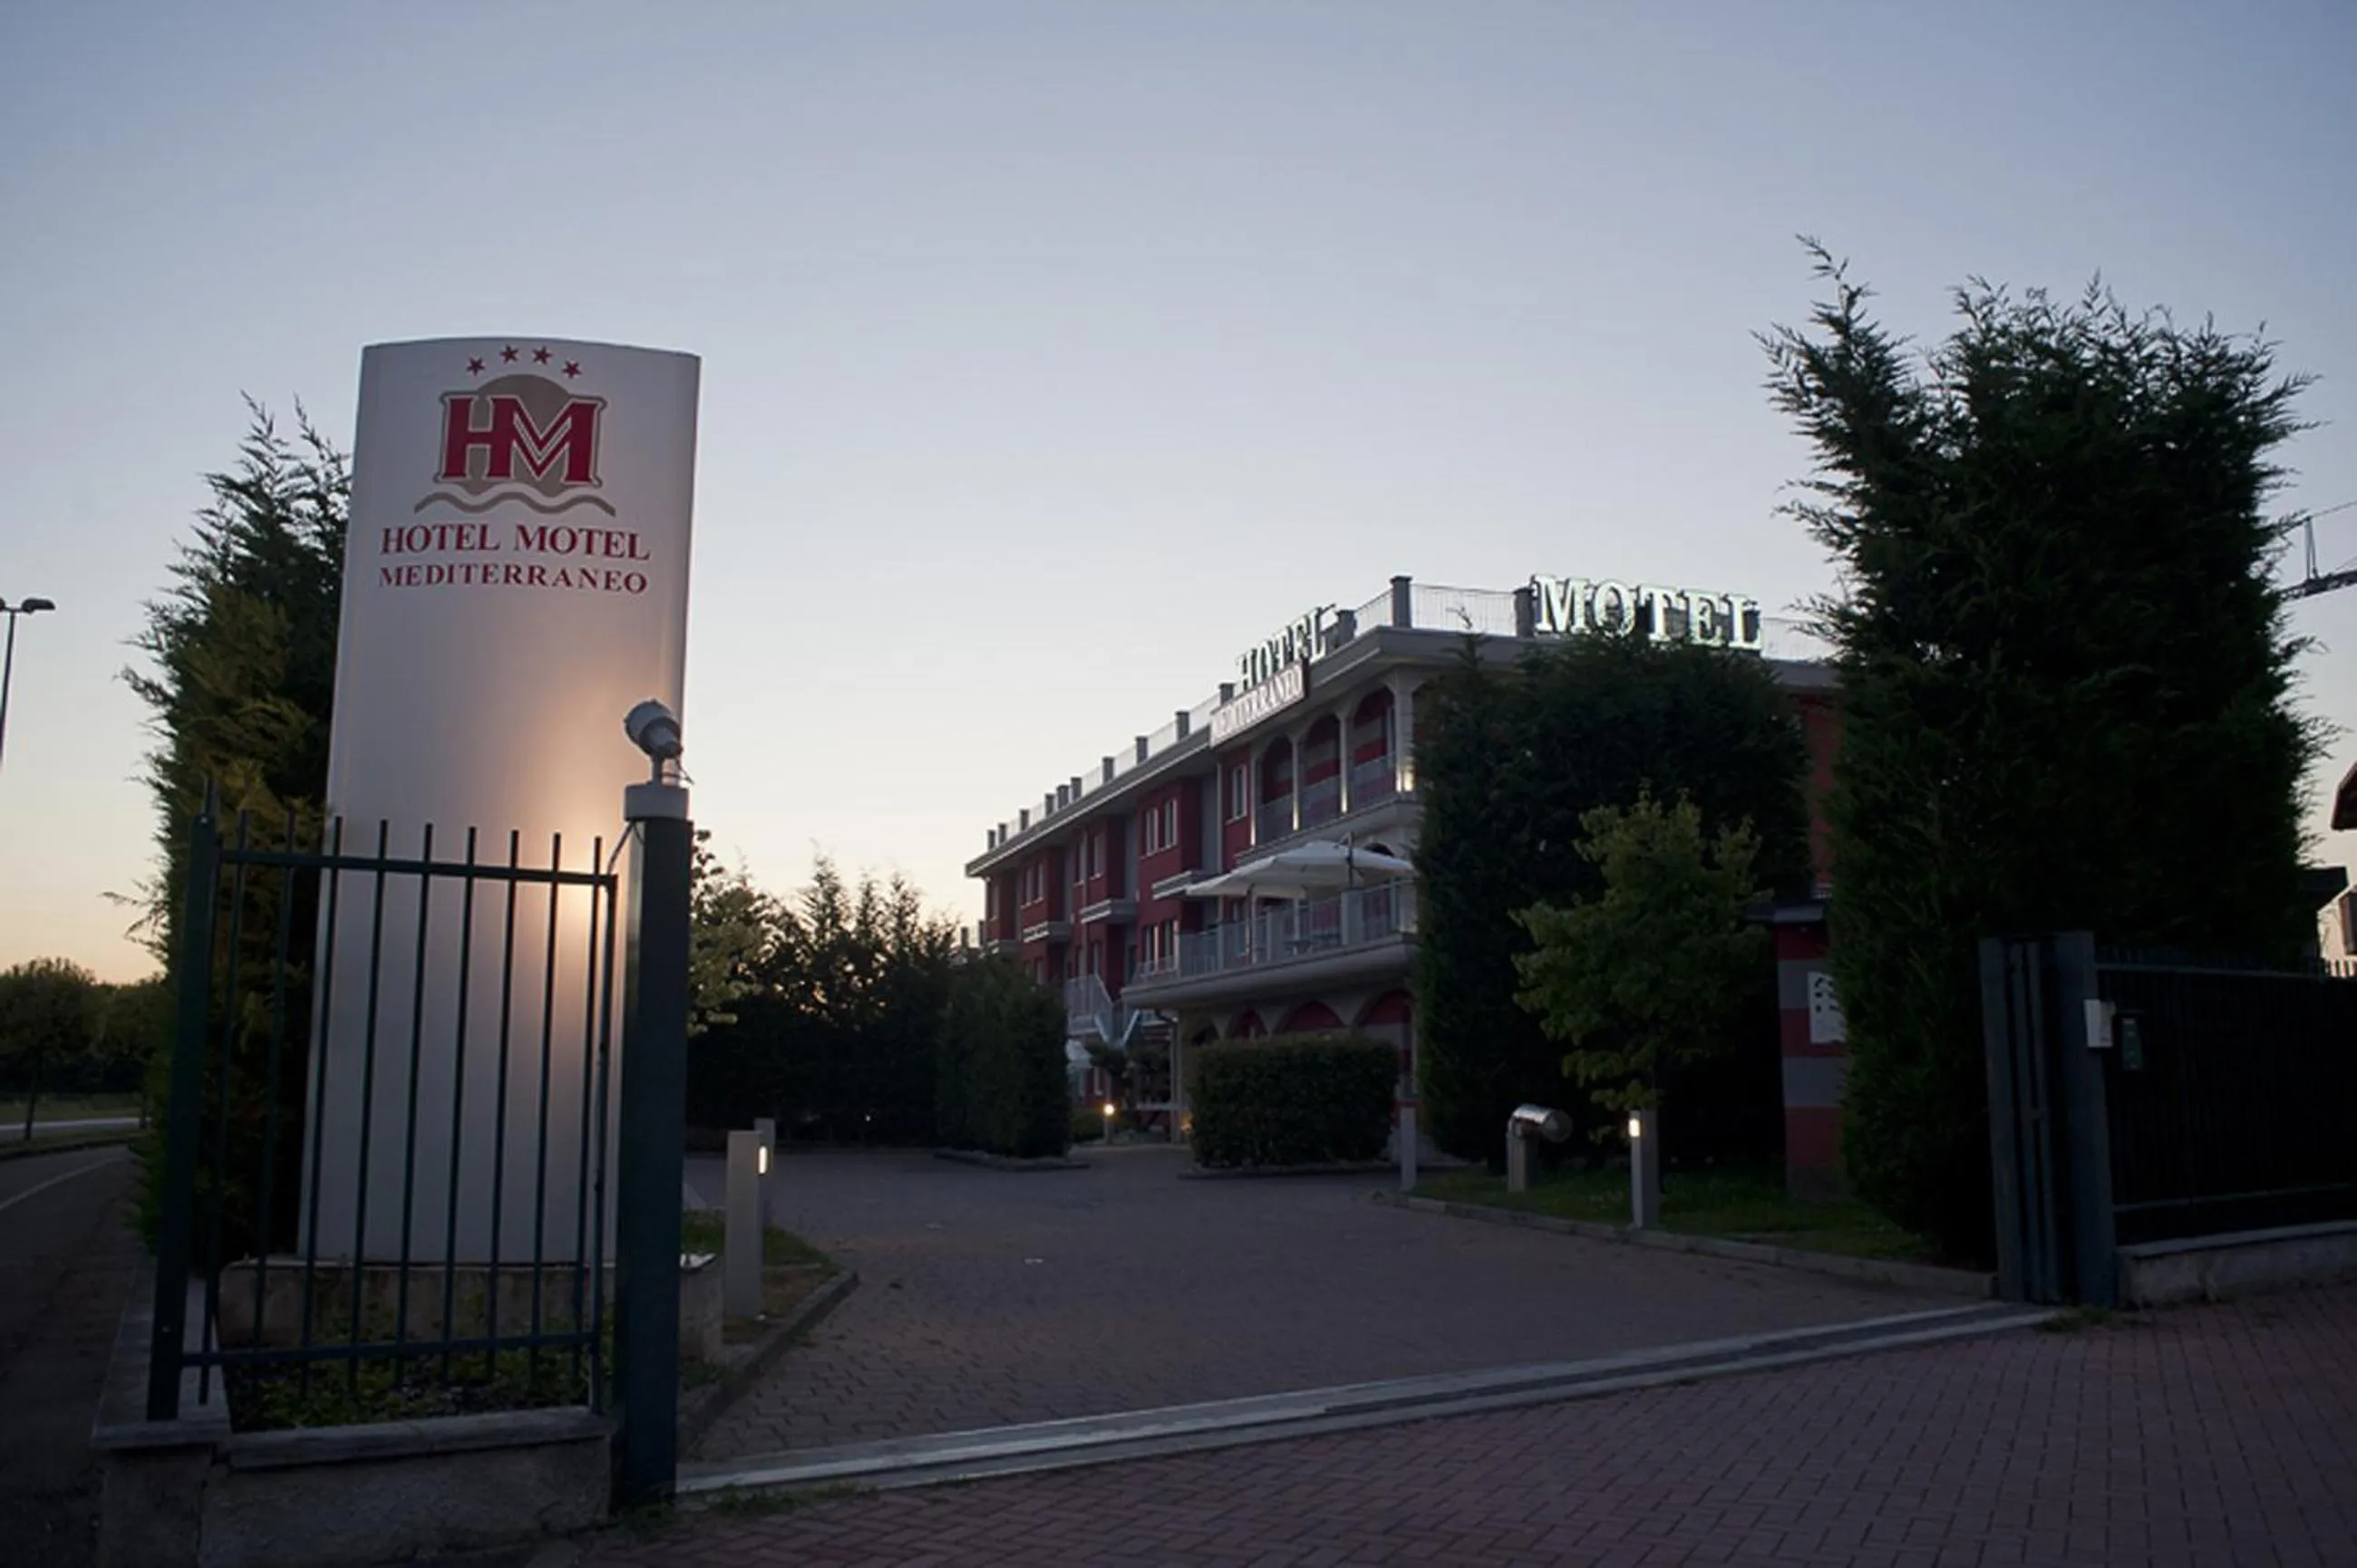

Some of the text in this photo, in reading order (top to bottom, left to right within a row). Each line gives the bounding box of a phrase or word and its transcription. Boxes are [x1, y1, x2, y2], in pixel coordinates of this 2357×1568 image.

[437, 392, 606, 488] HM
[379, 563, 648, 595] MEDITERRANEO
[380, 524, 651, 561] HOTEL MOTEL
[1532, 574, 1761, 649] MOTEL
[1235, 606, 1326, 695] HOTEL
